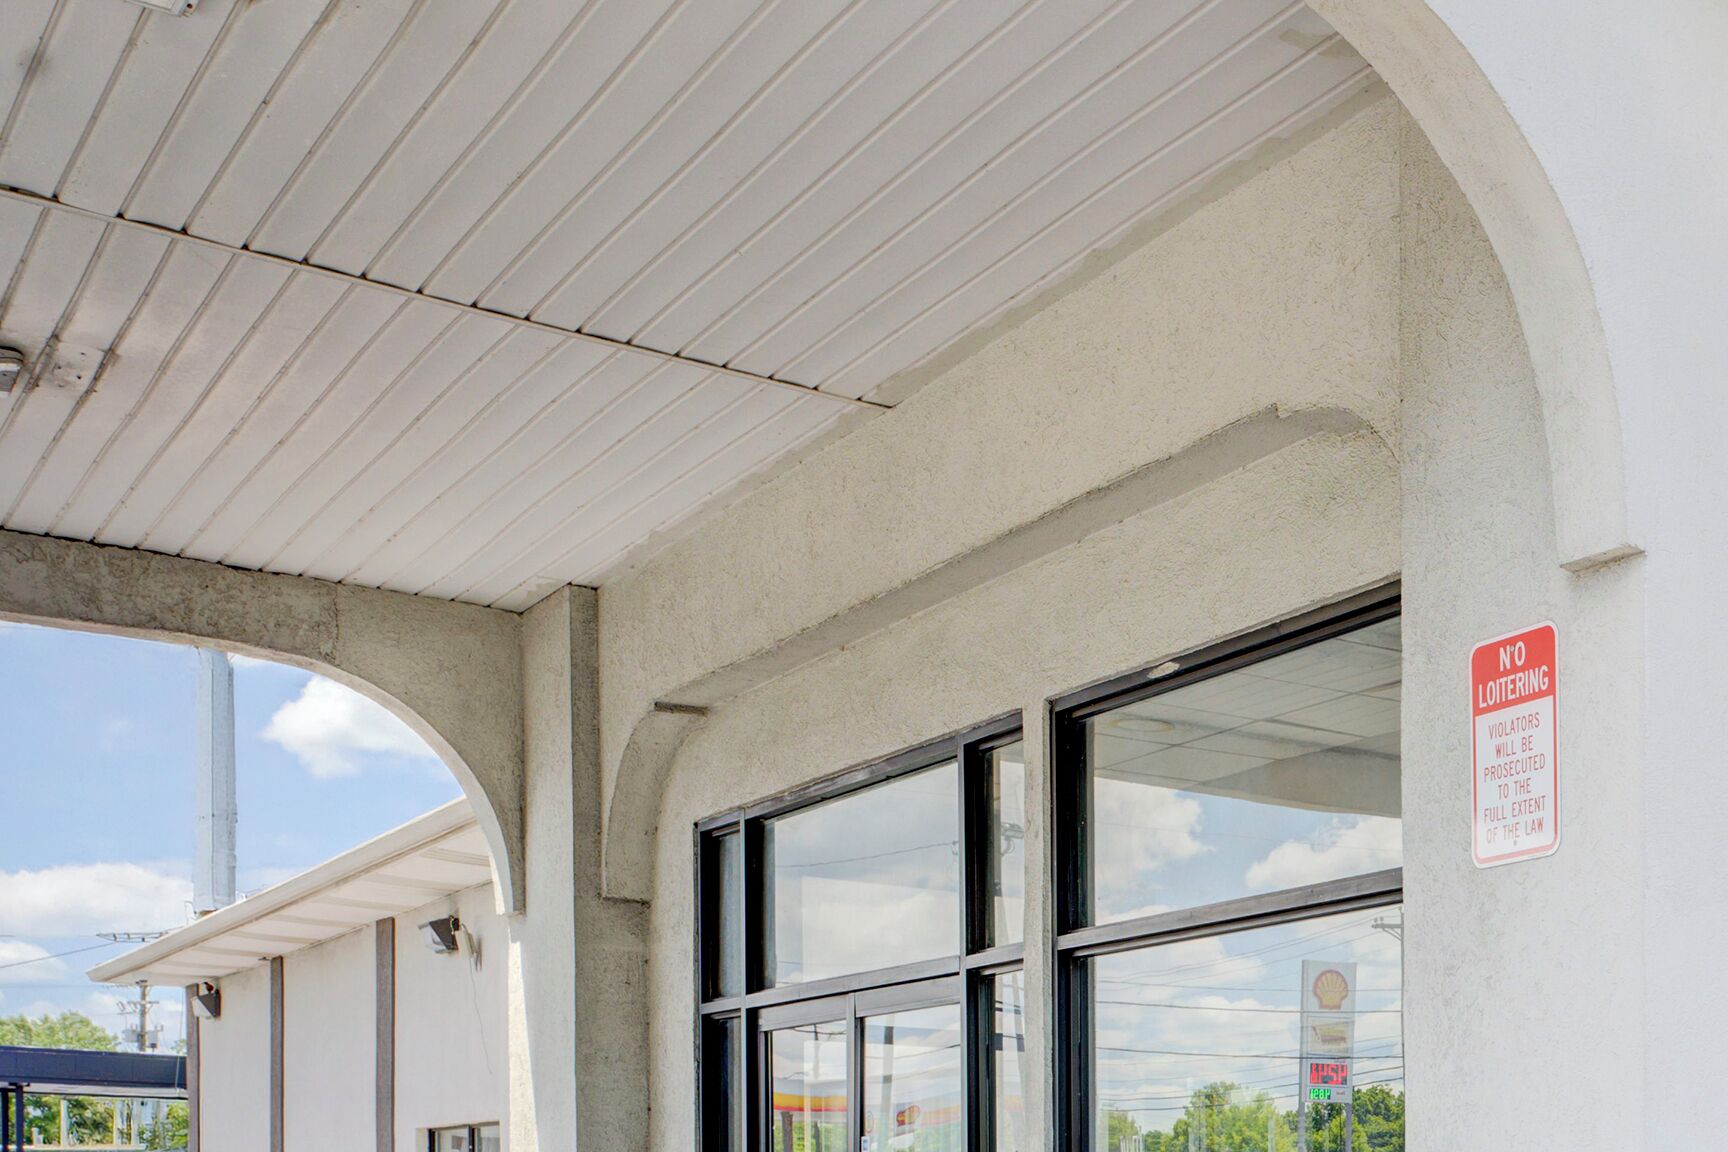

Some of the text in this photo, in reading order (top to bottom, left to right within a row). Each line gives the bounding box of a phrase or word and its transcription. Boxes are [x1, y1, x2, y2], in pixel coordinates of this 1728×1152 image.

[1499, 641, 1526, 672] NO
[1478, 665, 1549, 708] LOITERING
[1488, 712, 1540, 740] VIOLATORS
[1495, 735, 1534, 759] WILL BE
[1484, 753, 1546, 783] PROSECUTED
[1498, 777, 1532, 800] TO THE
[1484, 795, 1546, 824] FULL EXTENT
[1486, 816, 1544, 844] OF THE LAW
